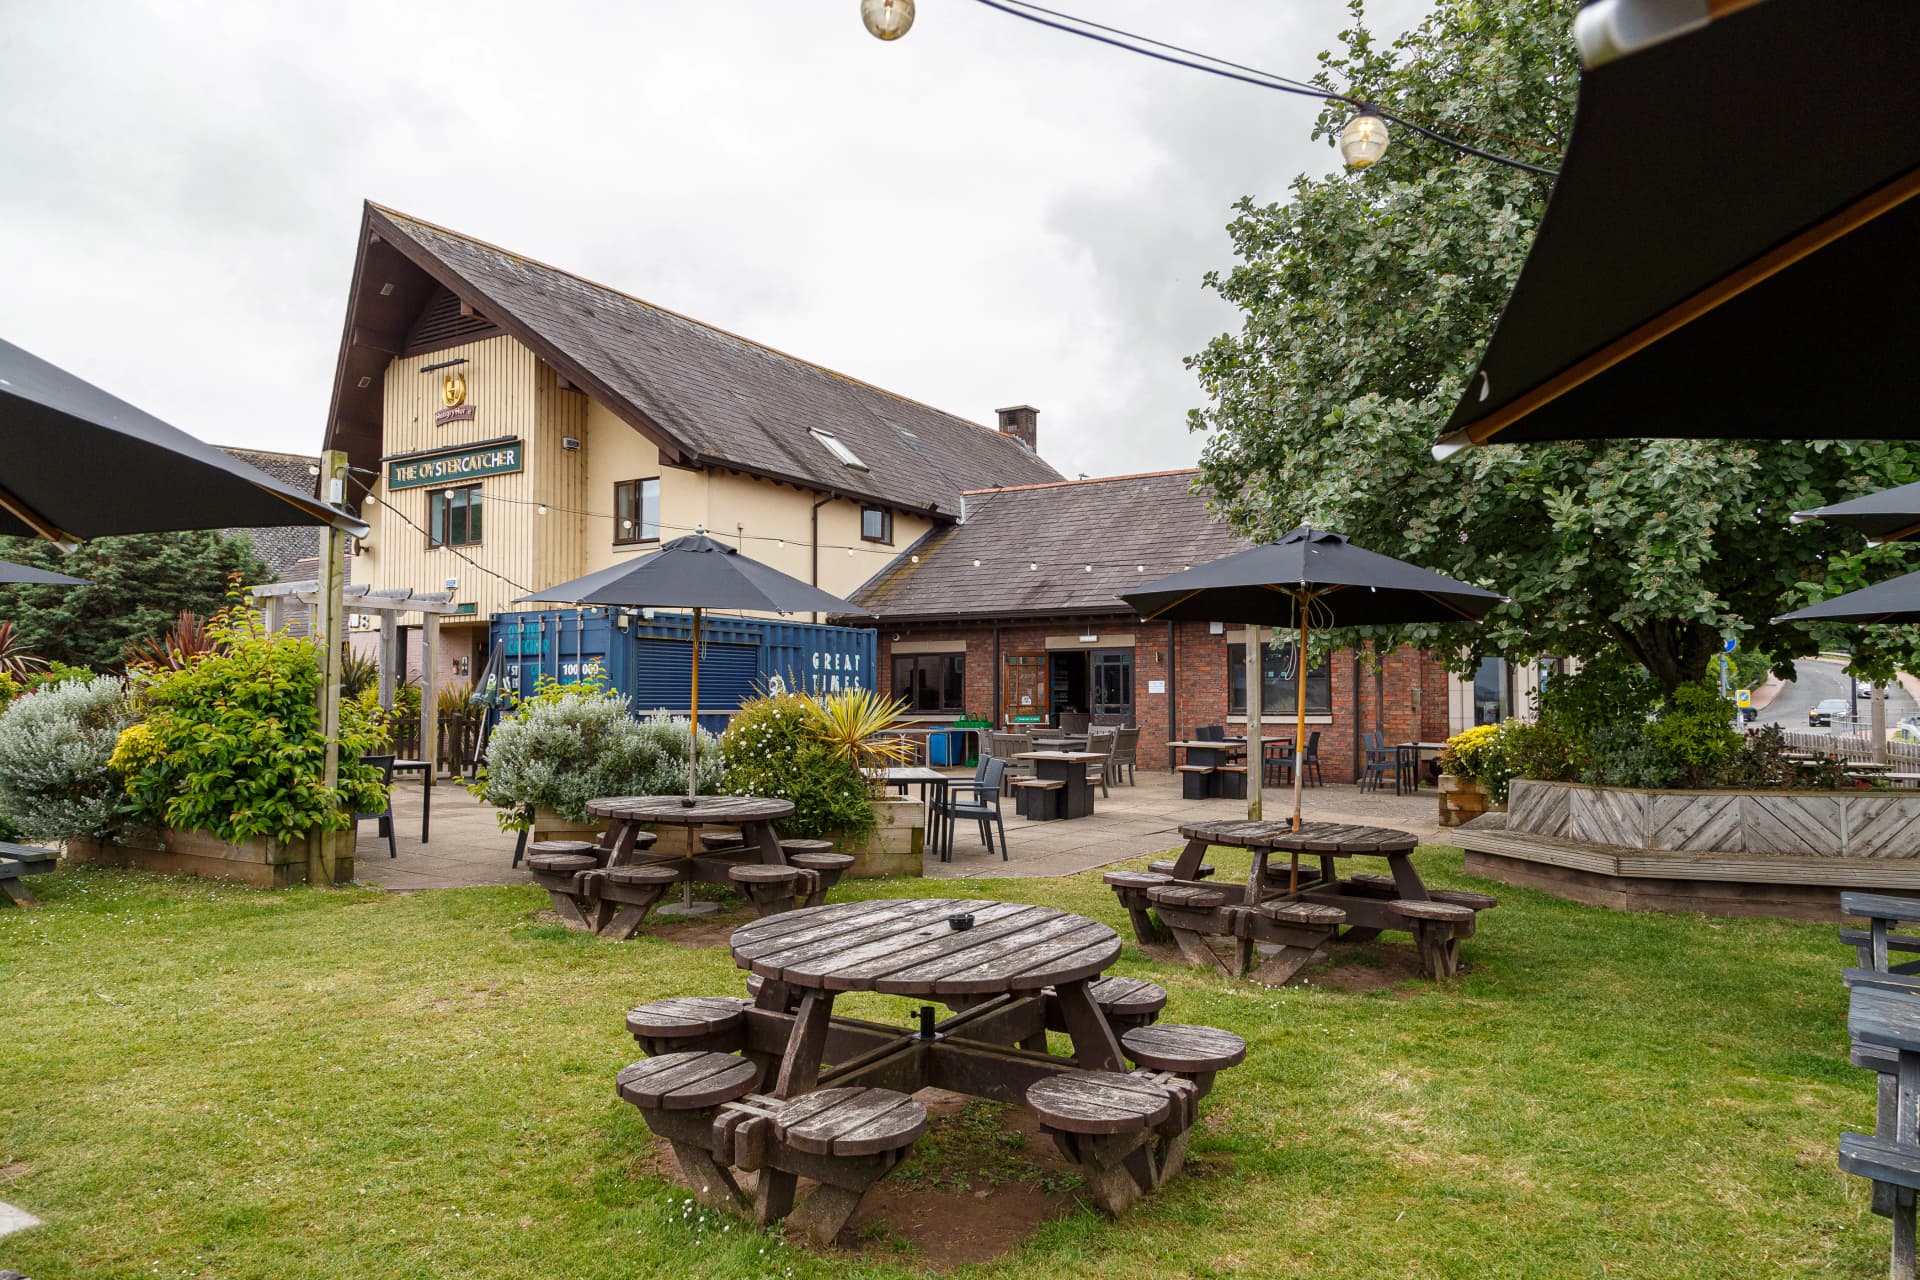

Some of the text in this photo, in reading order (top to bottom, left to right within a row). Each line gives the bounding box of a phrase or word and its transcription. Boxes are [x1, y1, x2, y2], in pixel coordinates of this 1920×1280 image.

[396, 450, 515, 481] THE OYSTERCATCHER
[812, 652, 861, 671] GREAT
[812, 674, 861, 692] TIMES
